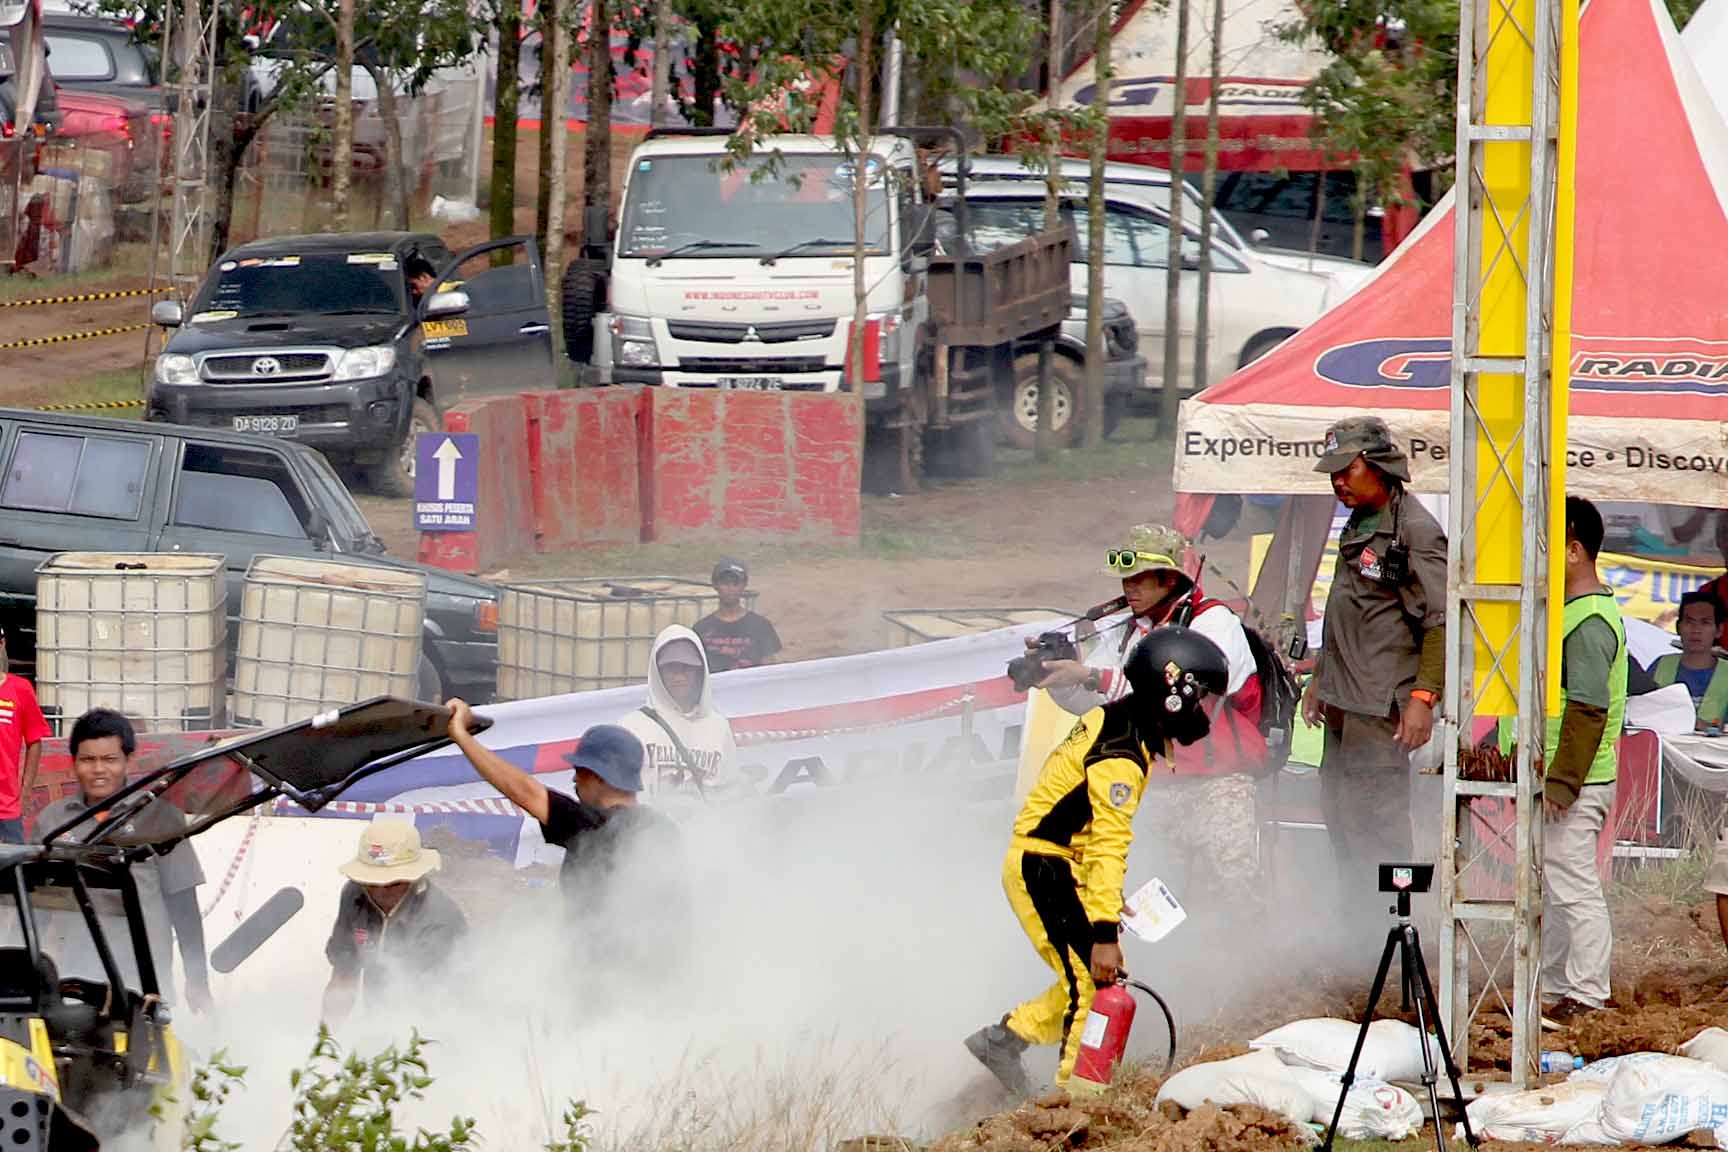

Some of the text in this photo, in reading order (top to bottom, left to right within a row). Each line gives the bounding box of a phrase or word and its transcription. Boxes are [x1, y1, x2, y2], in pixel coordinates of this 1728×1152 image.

[252, 417, 279, 431] 9128
[1184, 431, 1327, 461] Experienc
[419, 514, 442, 524] SATU
